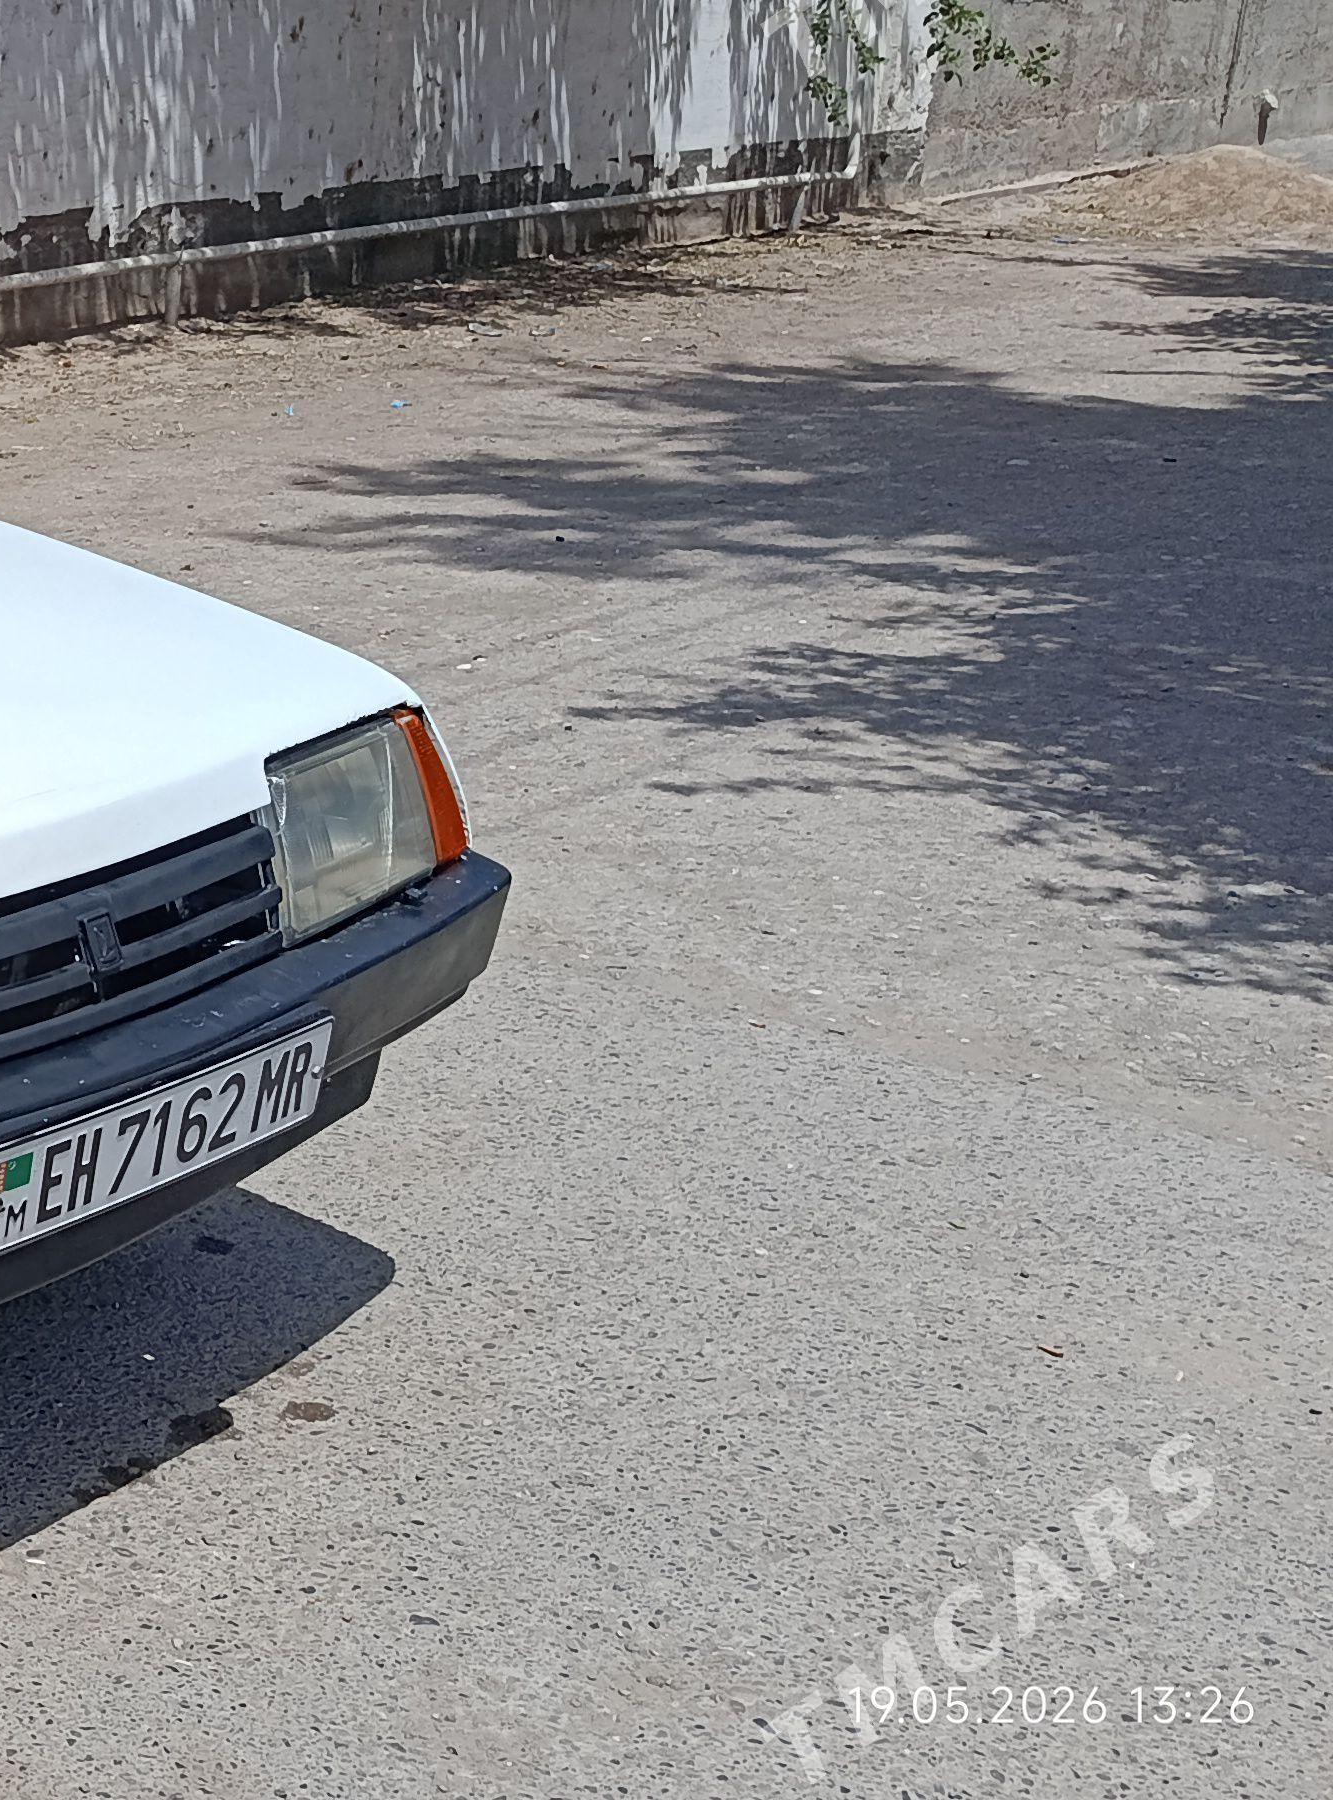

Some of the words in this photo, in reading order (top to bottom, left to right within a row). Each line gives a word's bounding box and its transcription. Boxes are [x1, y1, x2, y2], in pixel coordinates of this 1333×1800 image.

[36, 1127, 104, 1224] EH
[109, 1072, 246, 1196] 7162
[250, 1041, 313, 1133] MR
